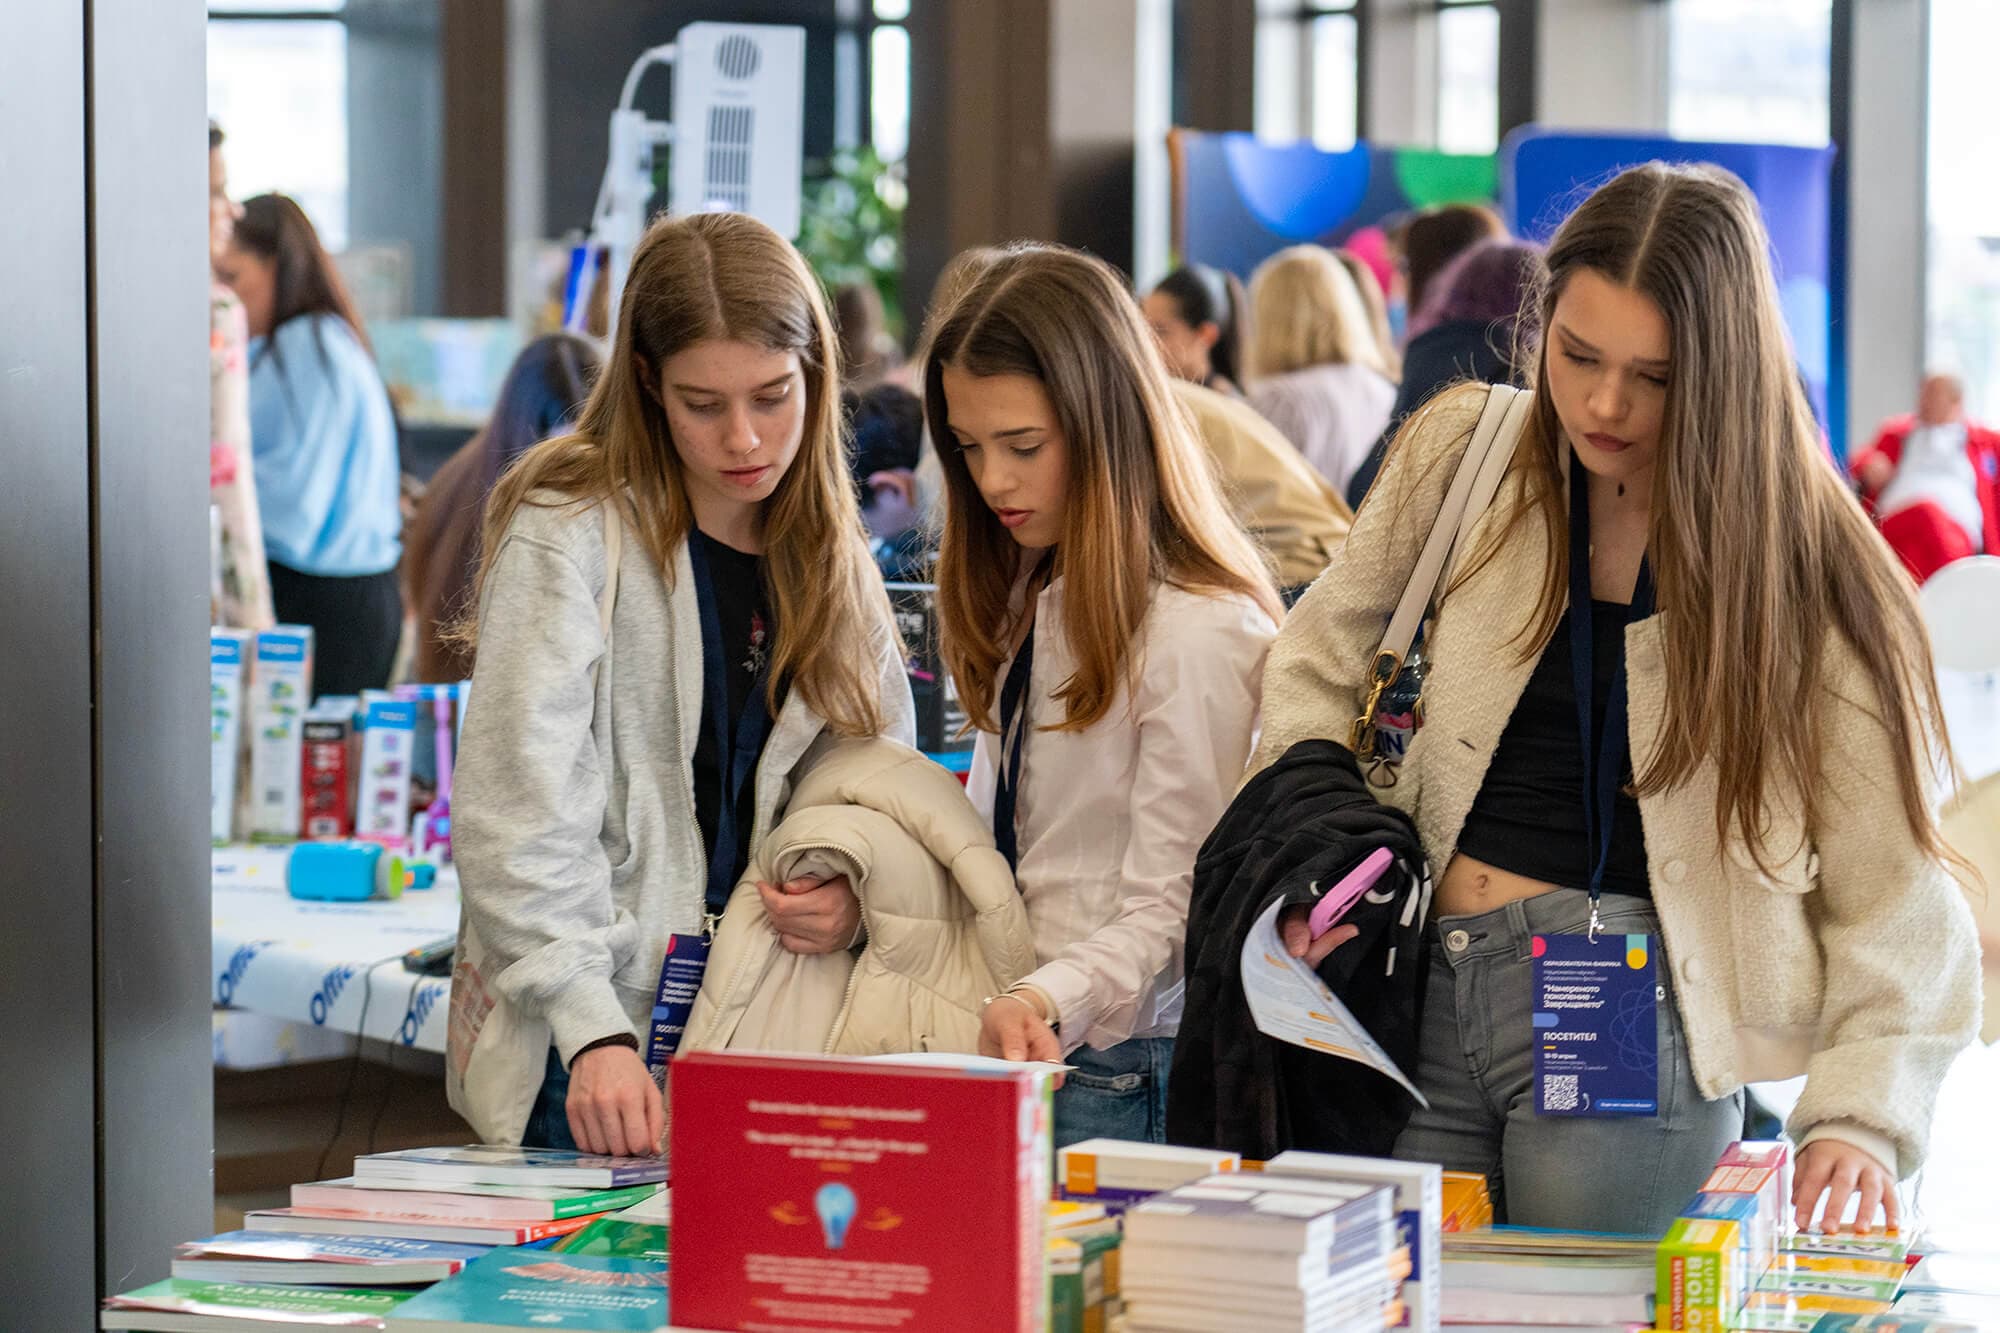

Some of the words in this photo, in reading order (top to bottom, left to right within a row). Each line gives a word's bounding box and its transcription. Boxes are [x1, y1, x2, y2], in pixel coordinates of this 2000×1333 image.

[1543, 1032, 1597, 1041] ПОСЕТИТЕЛ
[205, 1284, 394, 1303] Chemistry
[1673, 1259, 1683, 1313] REVISION
[1704, 1258, 1715, 1305] SUPER
